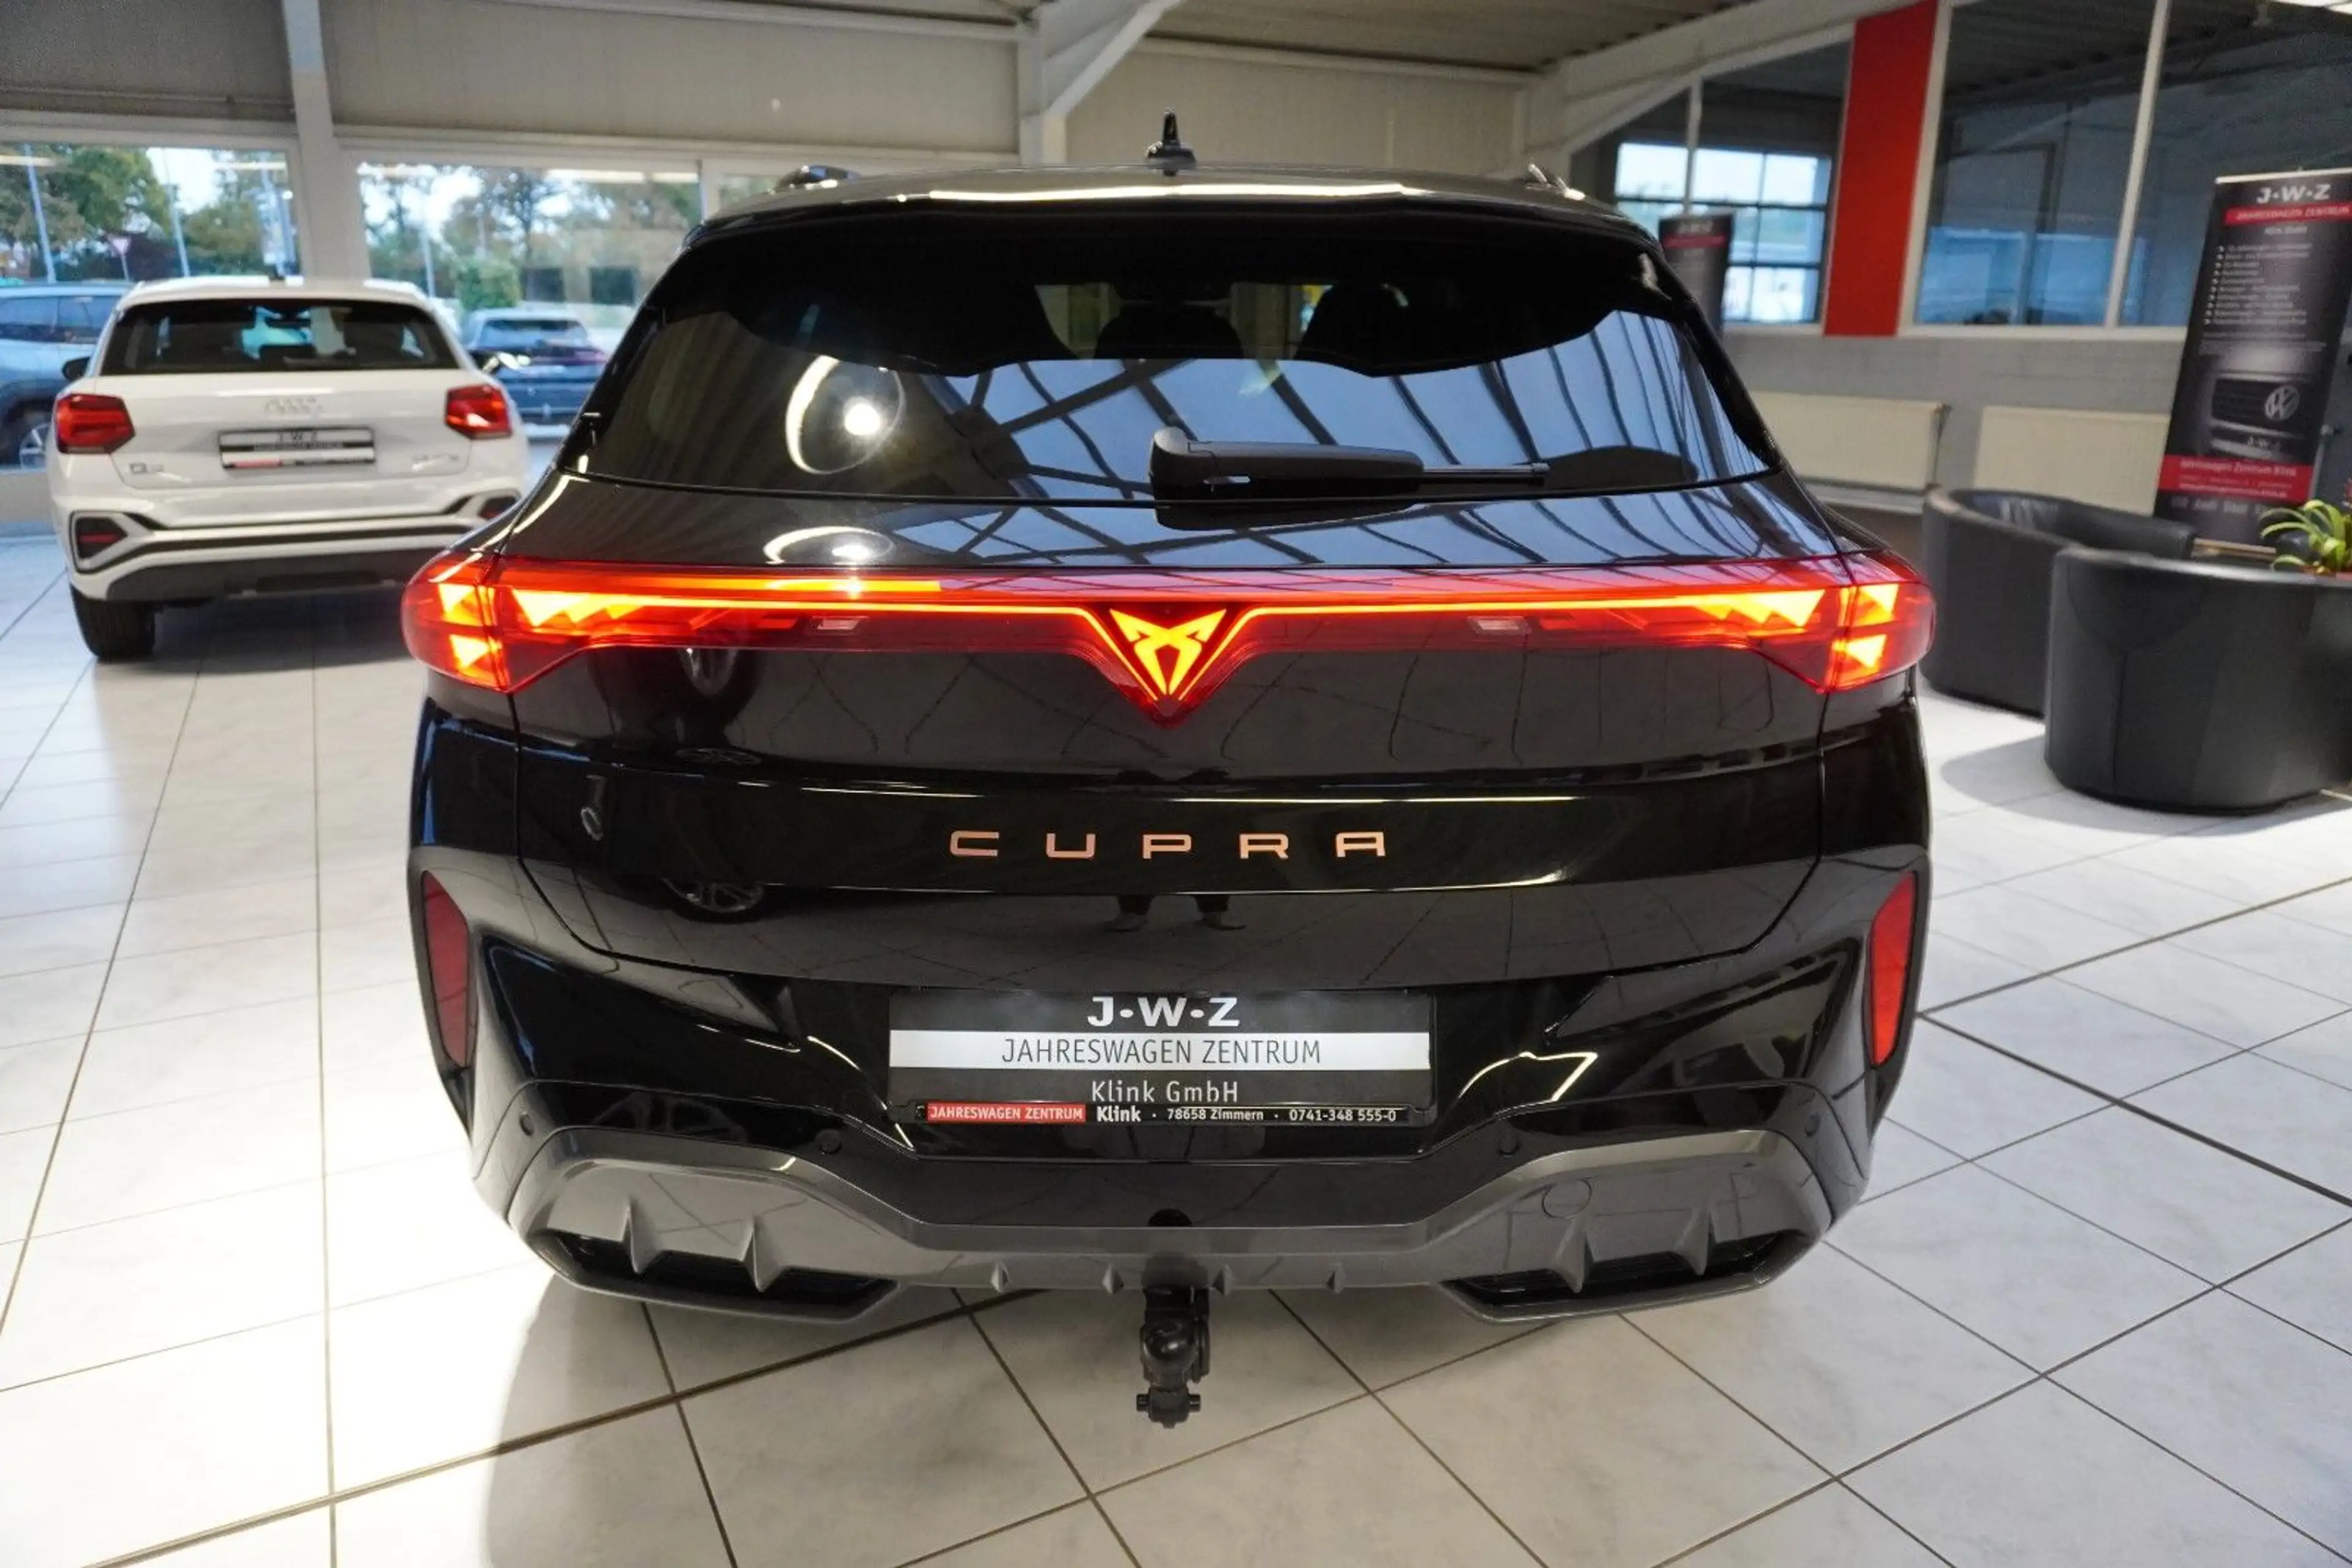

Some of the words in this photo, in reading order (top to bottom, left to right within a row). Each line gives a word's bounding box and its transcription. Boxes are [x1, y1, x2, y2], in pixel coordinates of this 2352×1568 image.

[950, 831, 1385, 859] CUPRA
[1002, 1039, 1191, 1064] JAHRESWAGEN
[1202, 1039, 1321, 1064] ZENTRUM
[1091, 1080, 1155, 1102] Klink
[1166, 1080, 1237, 1102] GmbH
[930, 1106, 1021, 1120] JAHRESWAGEN
[1025, 1107, 1083, 1120] ZENTRUM
[1096, 1105, 1142, 1123] Klink
[1167, 1109, 1207, 1120] 78658
[1289, 1109, 1354, 1121] 0741-348
[1357, 1110, 1396, 1122] 555-0
